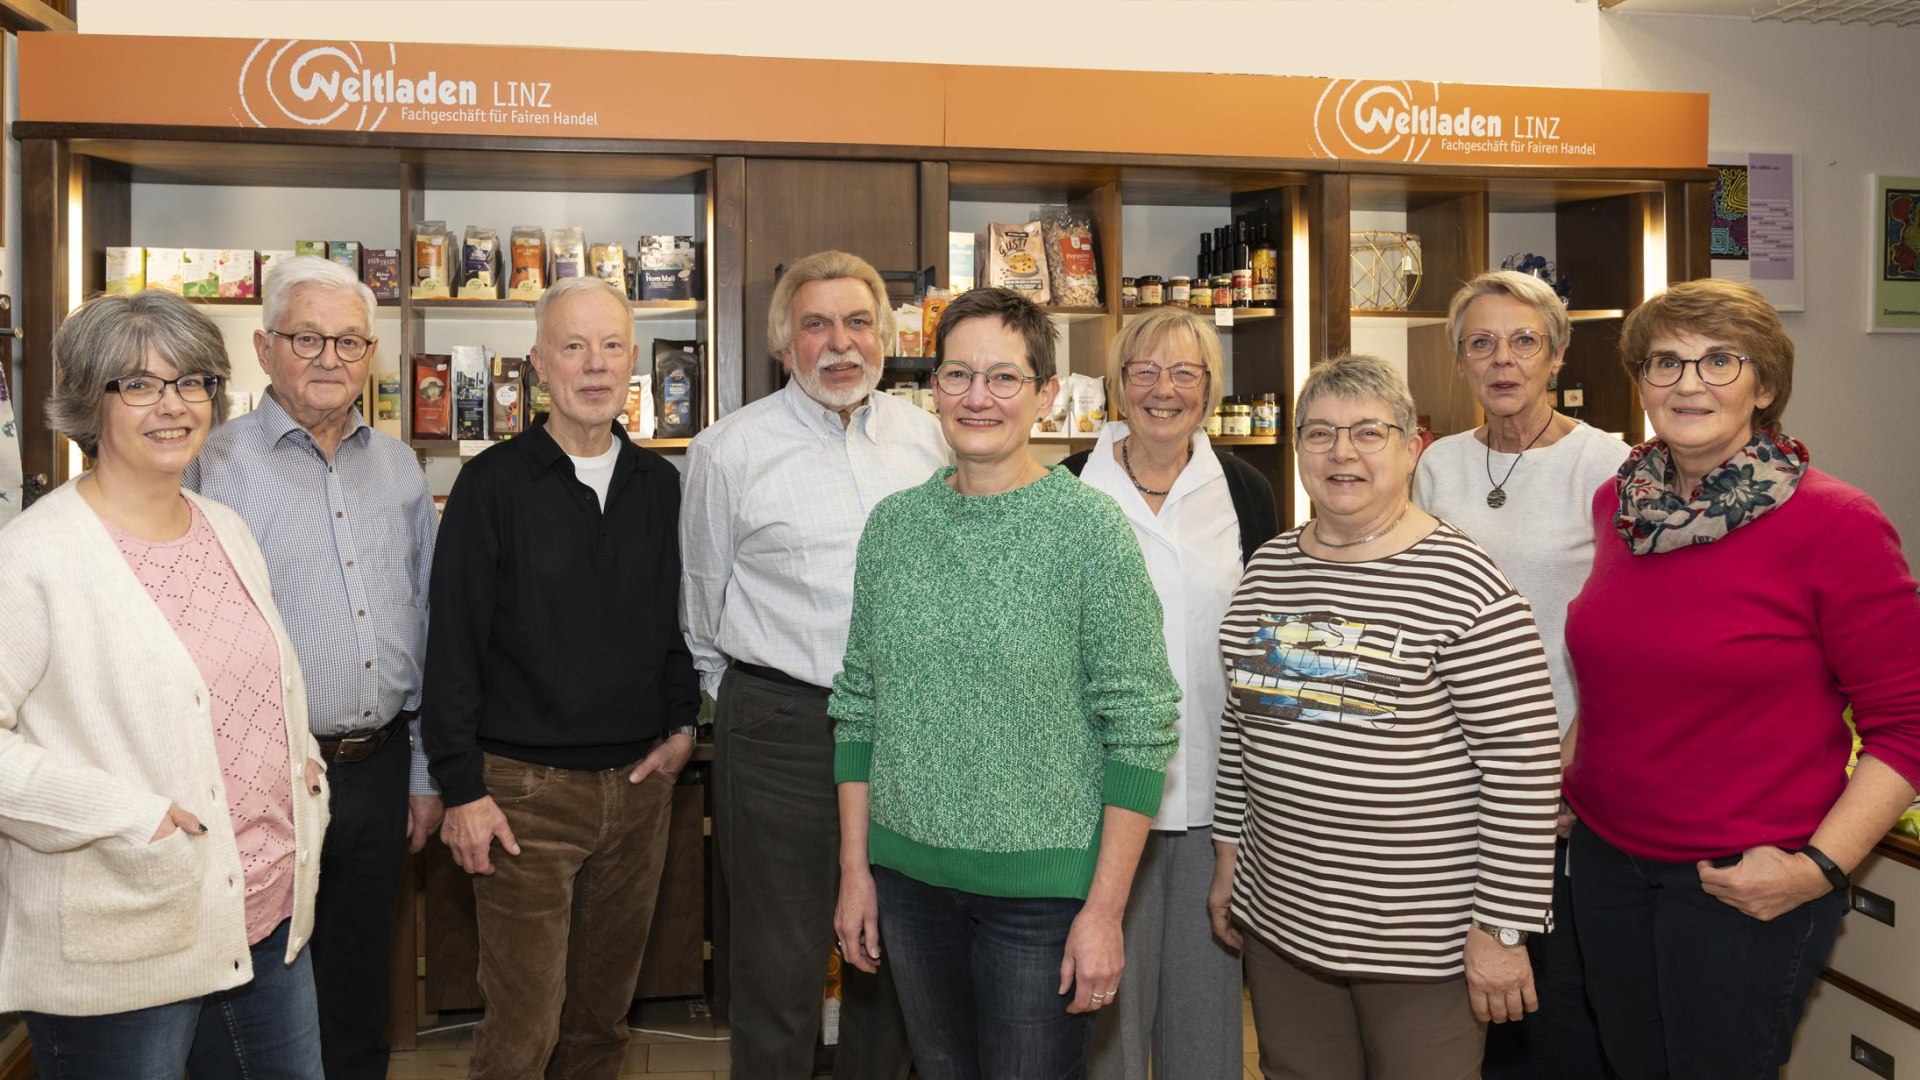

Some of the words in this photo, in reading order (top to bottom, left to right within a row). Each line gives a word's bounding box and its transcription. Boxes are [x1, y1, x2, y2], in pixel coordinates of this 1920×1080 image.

[290, 48, 477, 105] Weltladen
[493, 80, 553, 108] LINZ
[401, 107, 487, 125] Fachgeschäft
[489, 108, 508, 123] für
[511, 109, 549, 124] Fairen
[553, 111, 599, 126] Handel
[1354, 86, 1502, 138] Weltladen
[1514, 115, 1560, 139] LINZ
[1441, 138, 1508, 154] Fachgeschäft
[1510, 139, 1525, 153] für
[1527, 141, 1558, 154] Fairen
[1561, 142, 1597, 155] Handel
